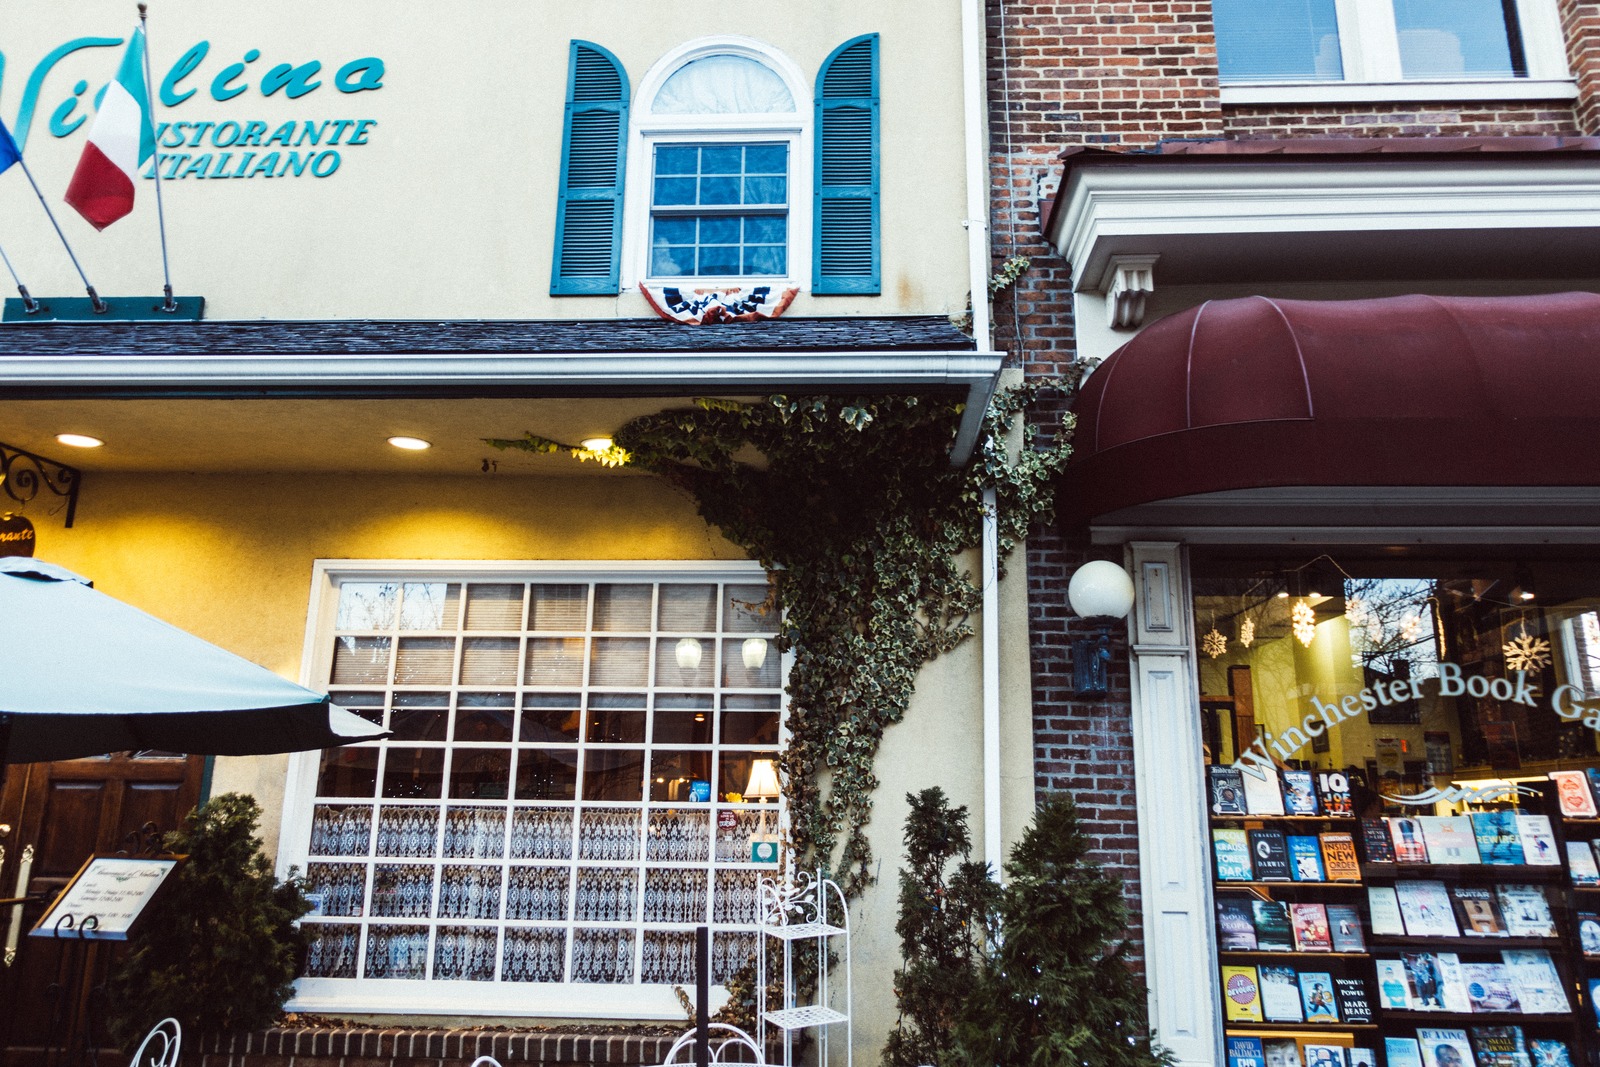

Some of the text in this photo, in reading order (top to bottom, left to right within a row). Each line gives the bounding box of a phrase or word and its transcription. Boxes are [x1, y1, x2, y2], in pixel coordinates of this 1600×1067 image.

[143, 151, 341, 179] ITALIANO
[1231, 676, 1426, 784] Winchester
[1438, 662, 1538, 708] Book
[1319, 773, 1350, 793] IQ
[1324, 843, 1353, 851] INSIDE
[1327, 851, 1354, 861] NEW
[1329, 861, 1357, 869] ORDER
[1218, 866, 1252, 878] DARK
[1455, 891, 1490, 899] GUITAR
[1442, 1031, 1466, 1040] KING
[1234, 1041, 1254, 1050] DAVID
